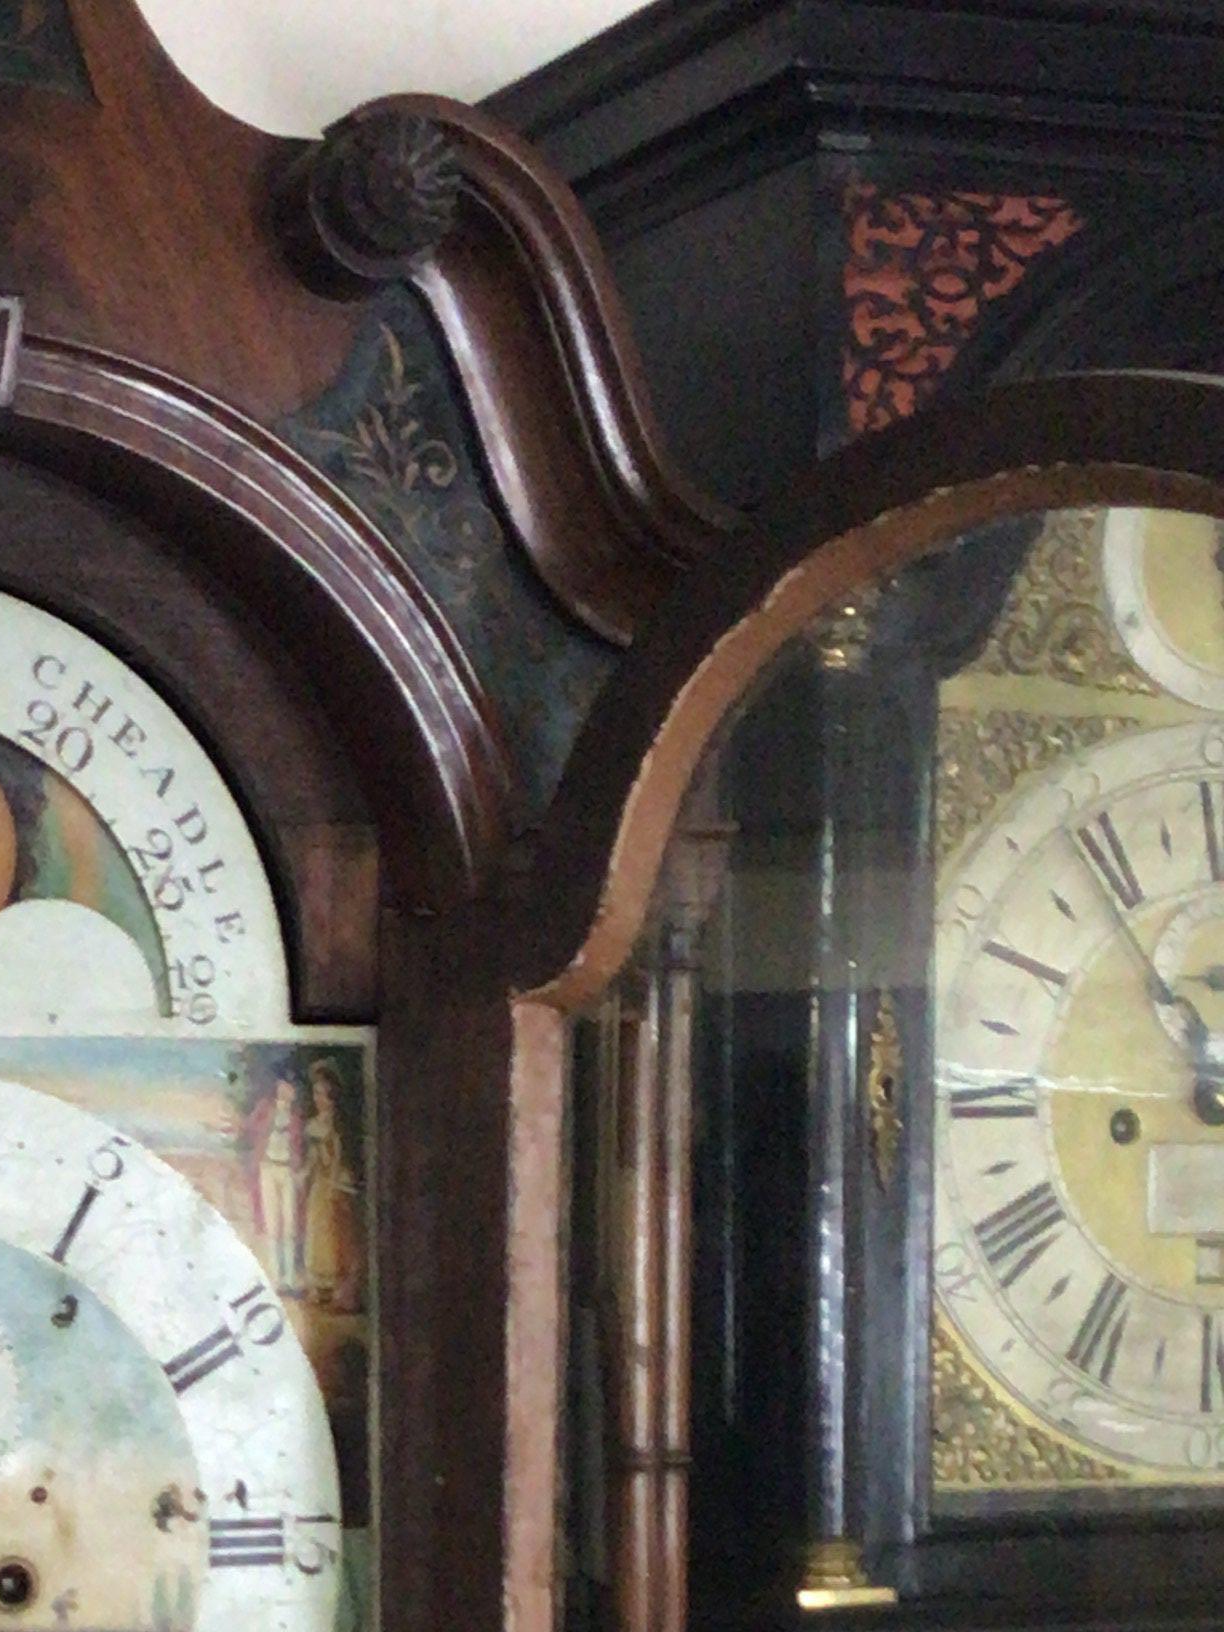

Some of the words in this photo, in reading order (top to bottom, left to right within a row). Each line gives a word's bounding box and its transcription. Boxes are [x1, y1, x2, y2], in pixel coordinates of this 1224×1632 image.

[18, 700, 95, 773] 20
[31, 654, 246, 945] CHEADLE
[129, 826, 196, 913] 25
[88, 1136, 130, 1181] 5
[46, 1180, 102, 1265] I
[972, 1181, 1067, 1290] VIII
[229, 1282, 284, 1346] 10
[1063, 1271, 1130, 1390] VII
[161, 1323, 244, 1394] II
[208, 1517, 284, 1568] III
[294, 1513, 336, 1575] 15
